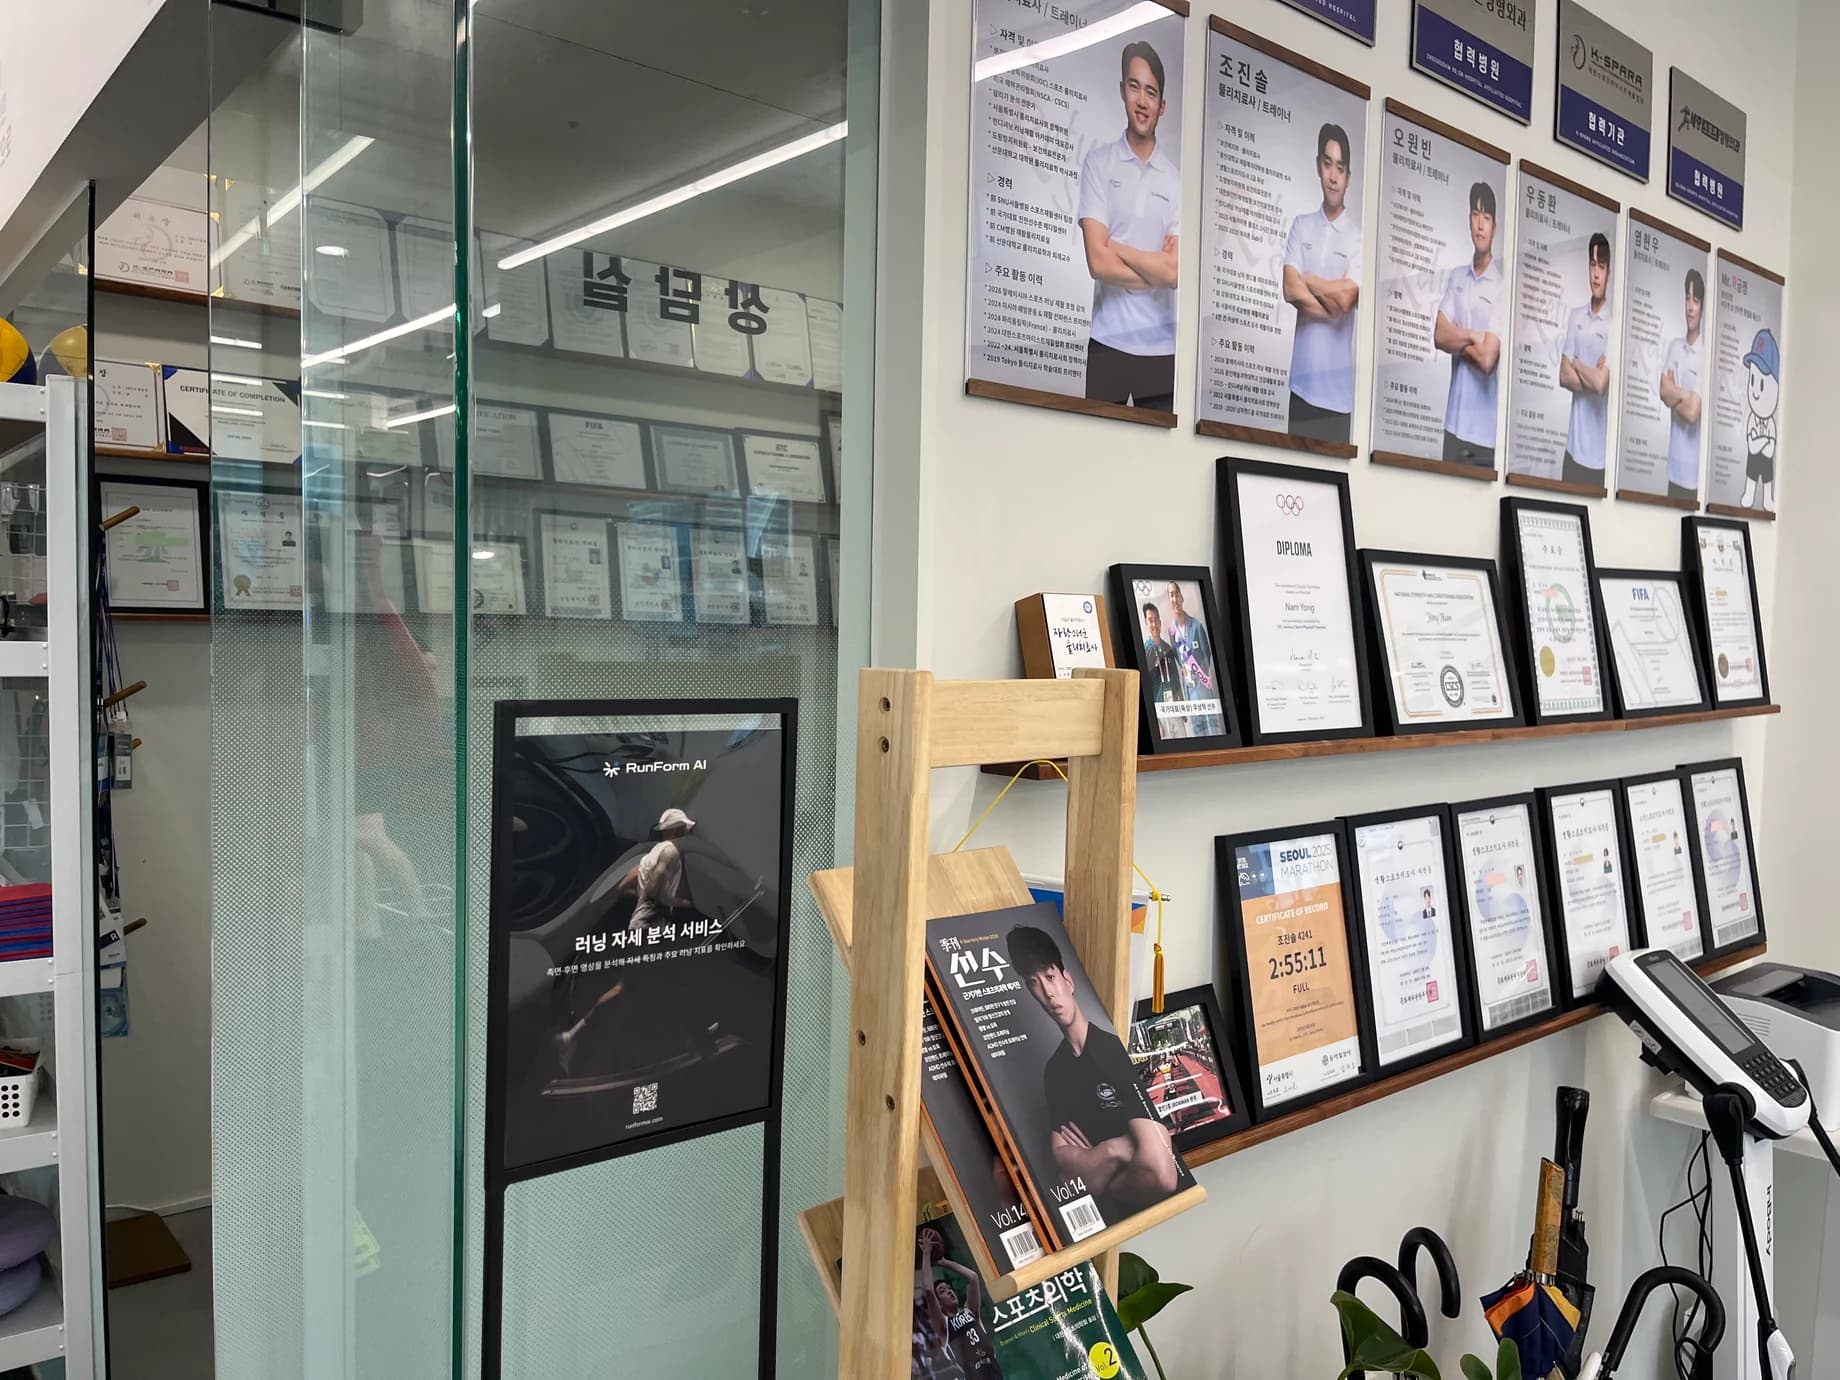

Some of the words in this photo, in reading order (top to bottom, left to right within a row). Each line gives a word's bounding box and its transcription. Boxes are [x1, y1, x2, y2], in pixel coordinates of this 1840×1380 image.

[1454, 39, 1500, 81] 협력병원
[1591, 47, 1643, 87] K-SPARA
[1218, 82, 1255, 110] 물리치료사
[1262, 99, 1290, 124] 트레이너
[1588, 112, 1625, 146] 협력기관
[997, 175, 1012, 189] 경력
[994, 263, 1009, 278] 주요
[1011, 267, 1026, 282] 활동
[1028, 272, 1042, 287] 이력
[1277, 540, 1312, 557] DIPLOMA
[1632, 587, 1649, 600] FIFA
[1285, 602, 1299, 612] Nam
[1299, 603, 1315, 614] Yong
[626, 761, 689, 773] RunForm
[693, 759, 707, 770] AI
[1280, 848, 1311, 863] SEOUL
[1312, 844, 1331, 858] 2025
[1281, 860, 1333, 878] MARATHON
[1256, 908, 1295, 925] CERTIFICATE
[1296, 906, 1304, 917] OF
[1305, 902, 1329, 914] RECORD
[575, 933, 607, 954] 러닝
[611, 928, 642, 949] 자세
[647, 923, 675, 945] 분석
[681, 918, 723, 939] 서비스
[1277, 932, 1297, 946] 조진솔
[1298, 929, 1313, 941] 4241
[950, 947, 1010, 988] 선수
[1269, 946, 1327, 980] 2:55:11
[1292, 983, 1310, 995] FULL
[1050, 1177, 1087, 1203] Vol.14
[990, 1203, 1026, 1230] Vol.14
[993, 1267, 1088, 1333] 스포츠의학
[1029, 1320, 1050, 1334] Clinical
[1067, 1299, 1092, 1314] Medicine
[966, 1328, 980, 1346] 33
[1103, 1347, 1117, 1366] 2
